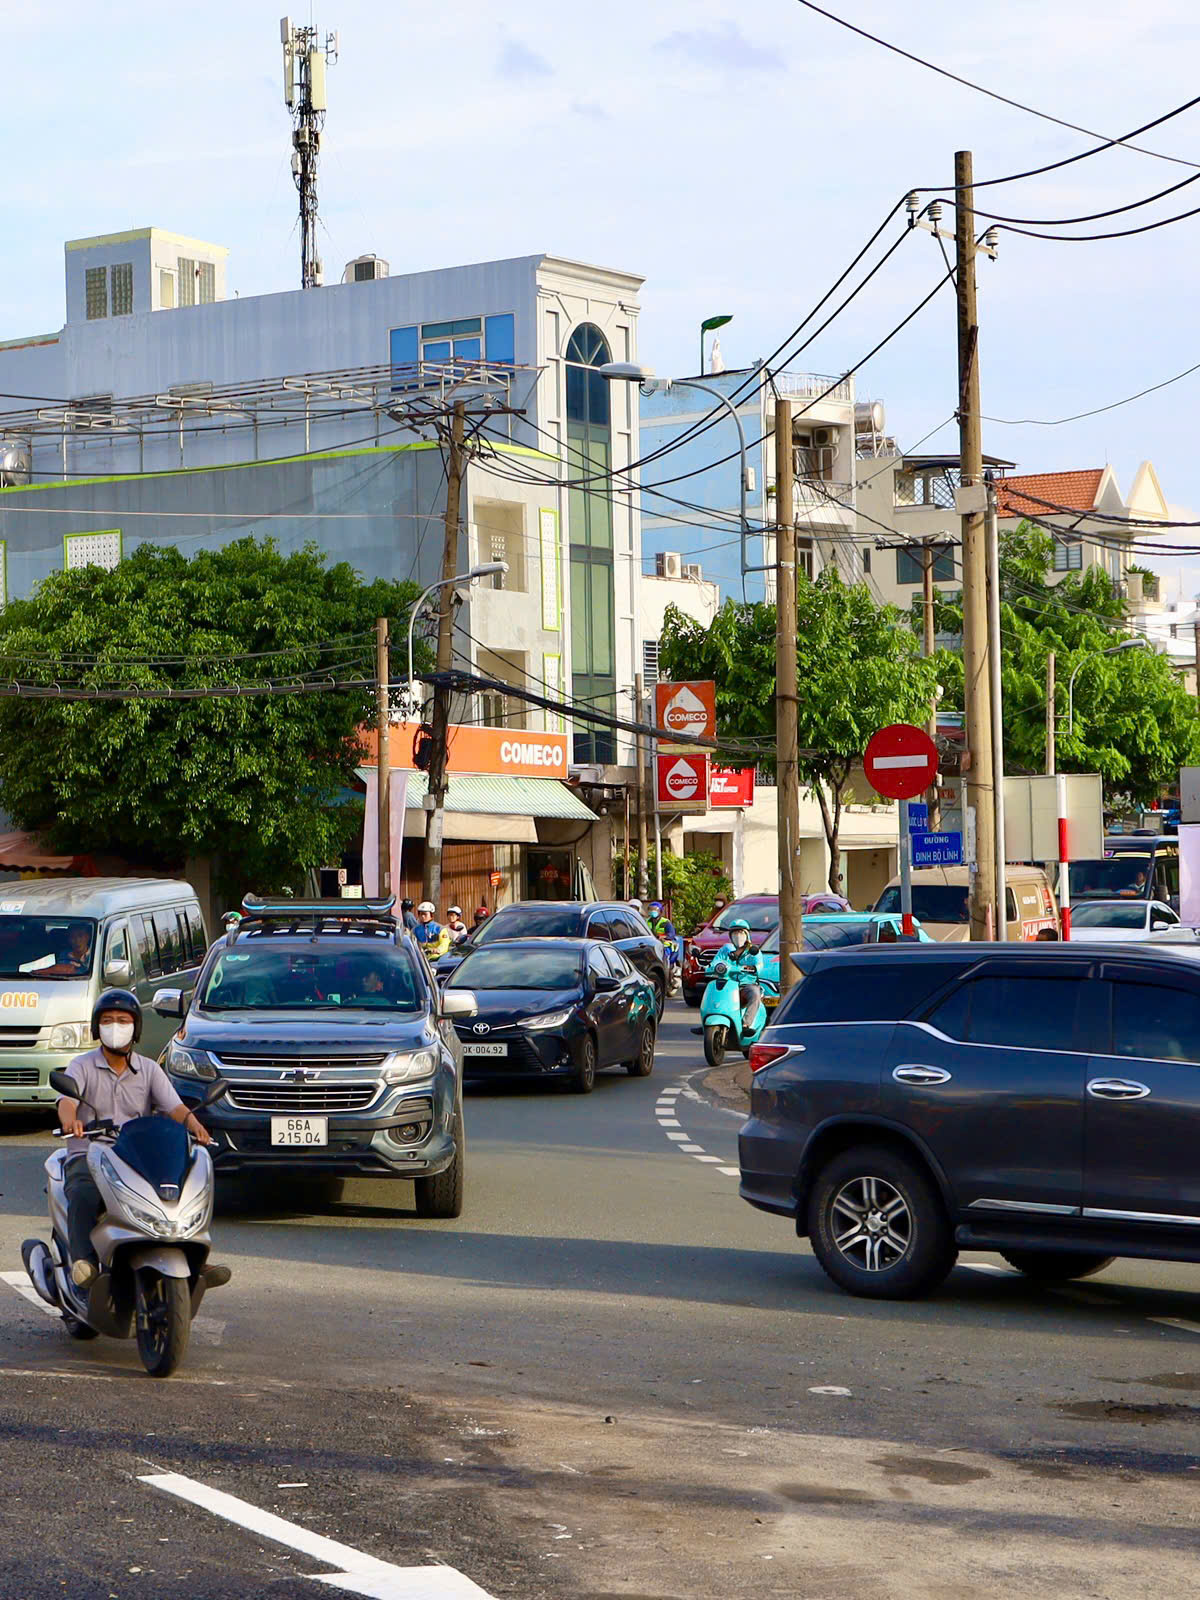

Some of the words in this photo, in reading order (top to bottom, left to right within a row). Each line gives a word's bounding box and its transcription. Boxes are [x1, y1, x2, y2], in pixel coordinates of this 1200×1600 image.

[668, 713, 708, 722] COMECO
[500, 741, 563, 767] COMECO
[287, 1119, 311, 1131] 66A
[278, 1132, 321, 1144] 215.04
